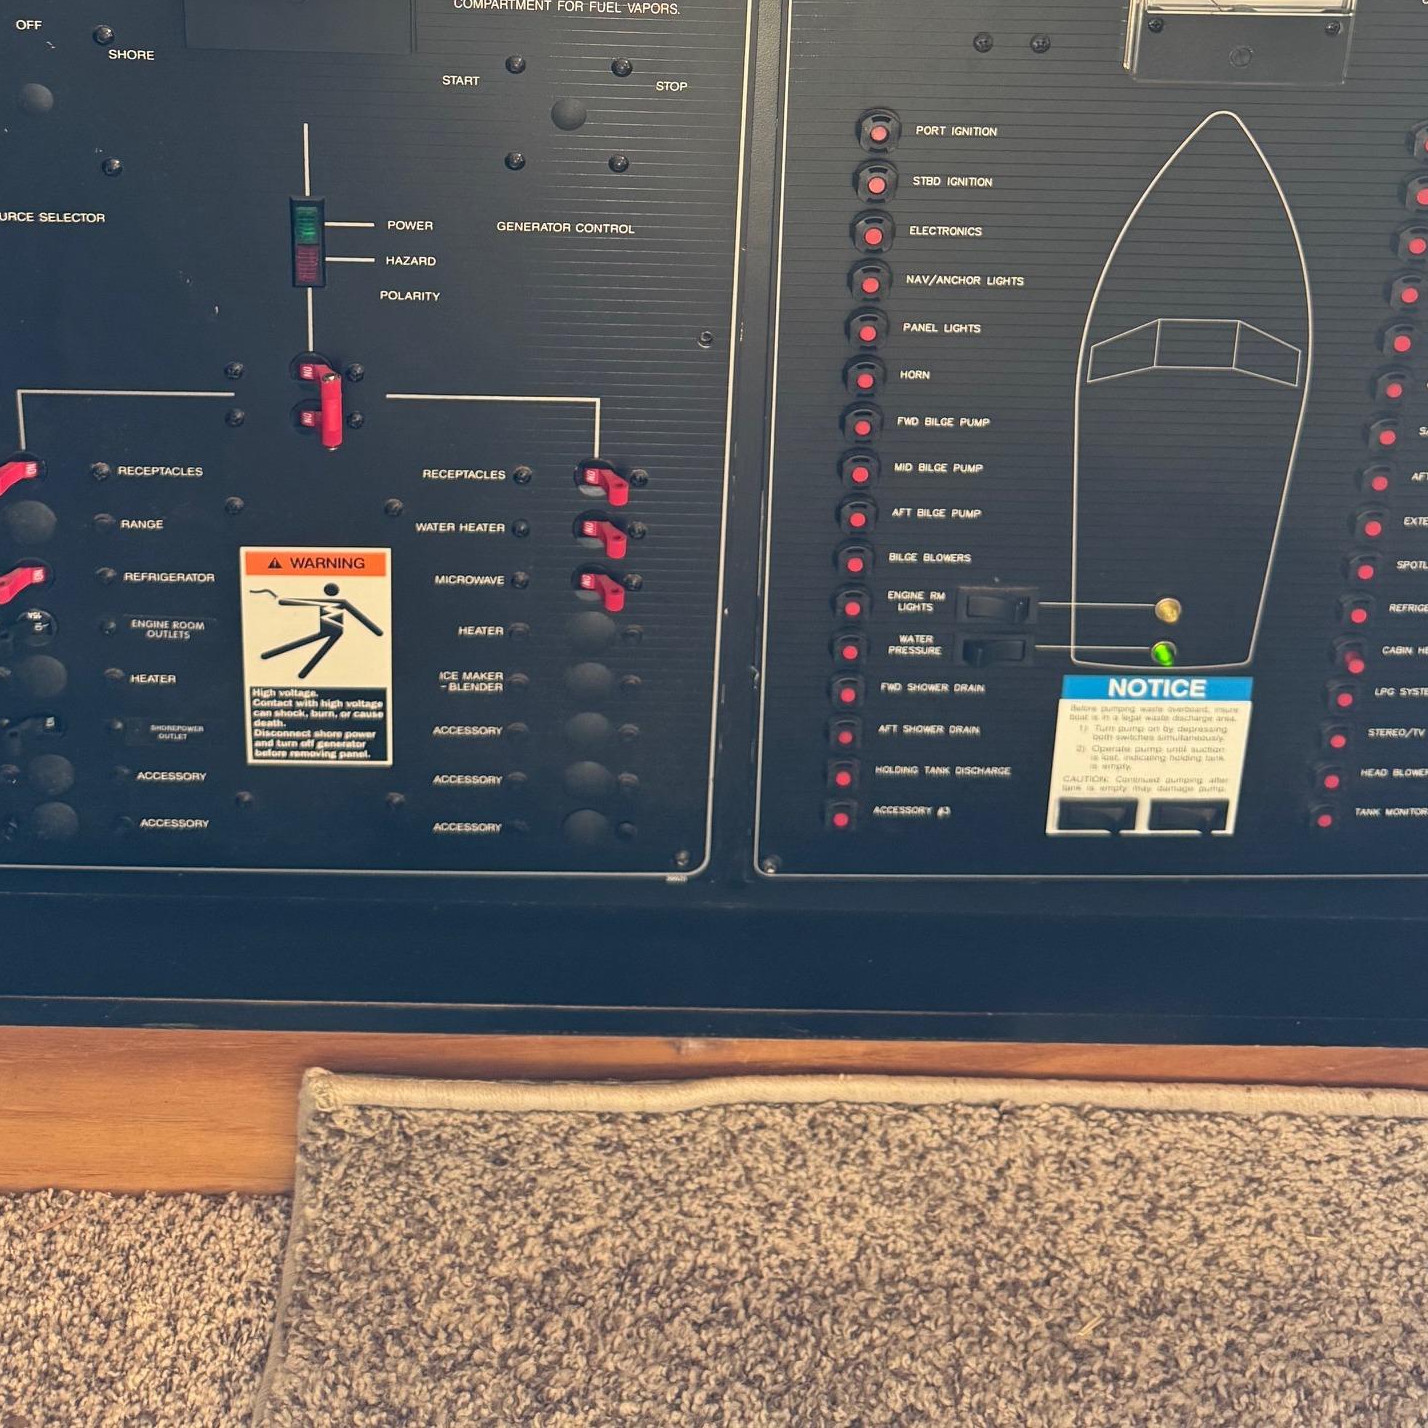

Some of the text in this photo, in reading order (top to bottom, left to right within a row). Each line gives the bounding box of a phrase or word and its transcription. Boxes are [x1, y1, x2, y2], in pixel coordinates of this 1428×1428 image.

[558, 0, 584, 12] FOR
[590, 1, 621, 13] FUEL
[627, 3, 680, 15] VAPORS.
[16, 20, 42, 30] OFF
[108, 50, 154, 61] SHORE
[442, 75, 480, 86] START
[656, 81, 687, 92] STOP
[916, 126, 997, 137] PORT IGNITION
[39, 212, 105, 223] SELECTOR
[387, 220, 433, 232] POWER
[497, 221, 635, 235] GENERATOR CONTROL
[909, 226, 982, 237] ELECTRONICS
[386, 255, 436, 267] HAZARD
[906, 275, 1024, 286] NAV/ANCHOR LIGHTS
[380, 290, 440, 303] POLARITY
[900, 370, 930, 380] HORN
[117, 465, 203, 478] RECEPTACLES
[121, 519, 163, 530] RANGE
[416, 522, 506, 534] WATER HEATER
[290, 557, 365, 570] WARNING
[124, 571, 215, 583] REFRIGERATOR
[435, 574, 504, 586] MICROWAVE
[131, 673, 176, 684] HEATER
[1108, 678, 1207, 698] NOTICE
[1368, 728, 1426, 738] STEREO/TV
[137, 770, 207, 783] ACCESSORY
